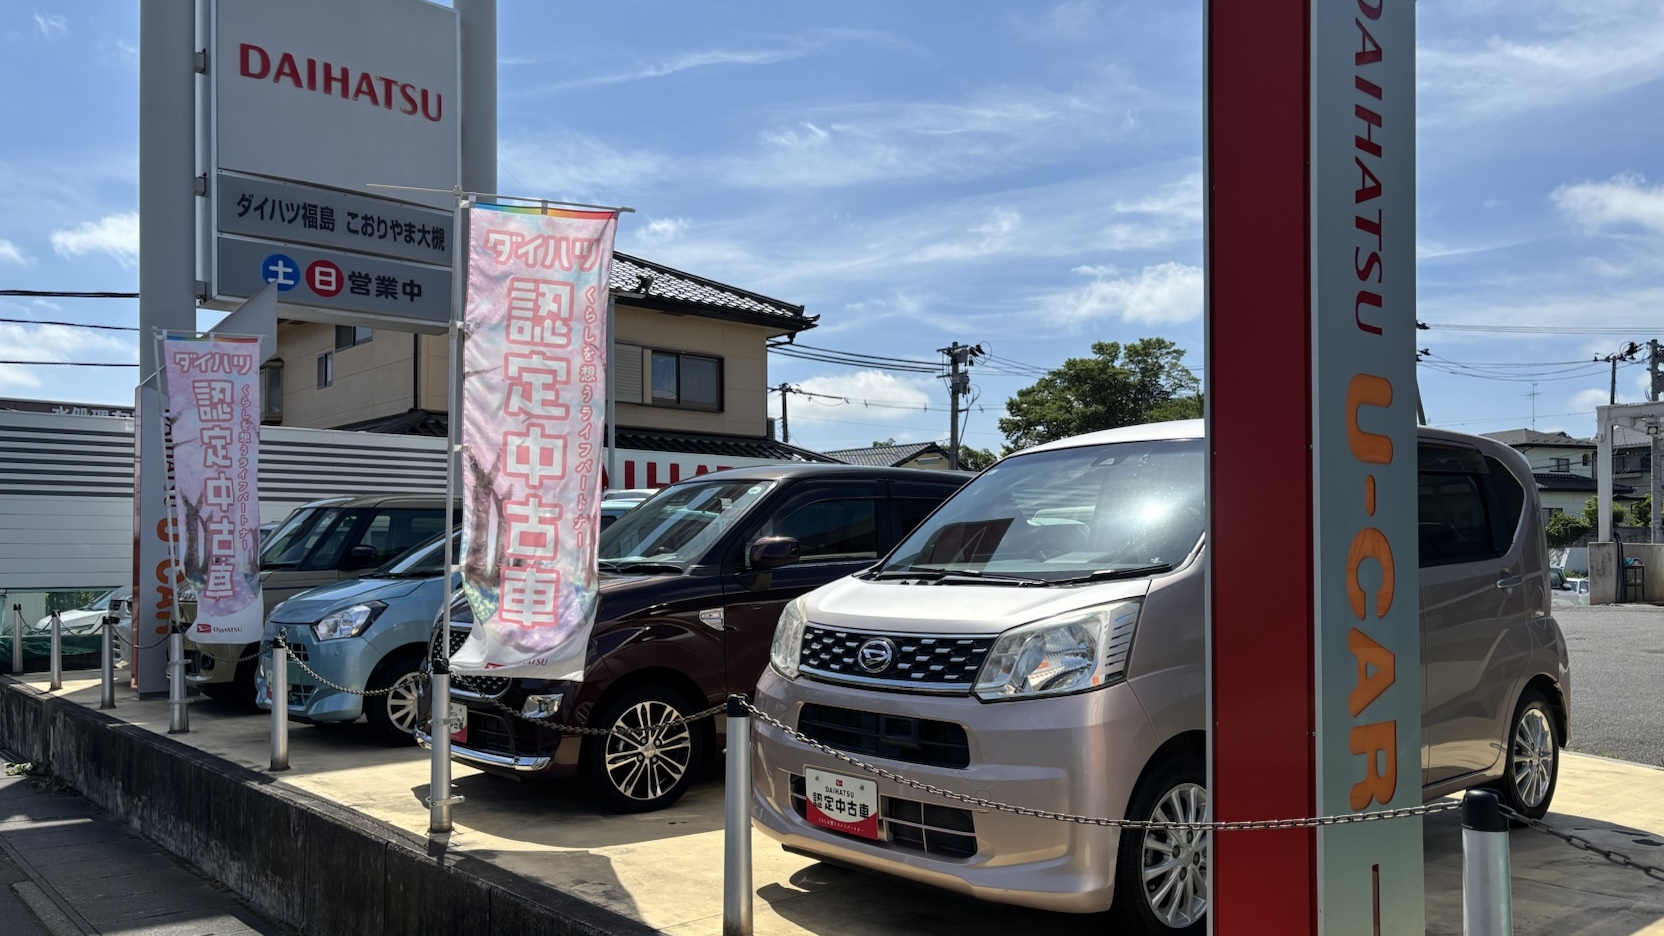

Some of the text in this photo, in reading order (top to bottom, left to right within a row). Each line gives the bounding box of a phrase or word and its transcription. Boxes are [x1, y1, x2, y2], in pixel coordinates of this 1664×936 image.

[239, 43, 443, 122] DAIHATSU
[236, 193, 446, 252] ダイハツ福島 こおりやま大槻
[485, 229, 602, 272] ダイハツ
[267, 260, 422, 302] 土 日 営業中
[173, 351, 253, 376] ダイハツ
[572, 285, 598, 549] くらしを想うライフパートナー
[500, 277, 575, 630] 認定中古車
[192, 379, 236, 602] 認定中古車
[1345, 371, 1397, 812] U-CAR
[812, 791, 869, 819] 認定中古車
[825, 786, 855, 799] DAIHATSU
